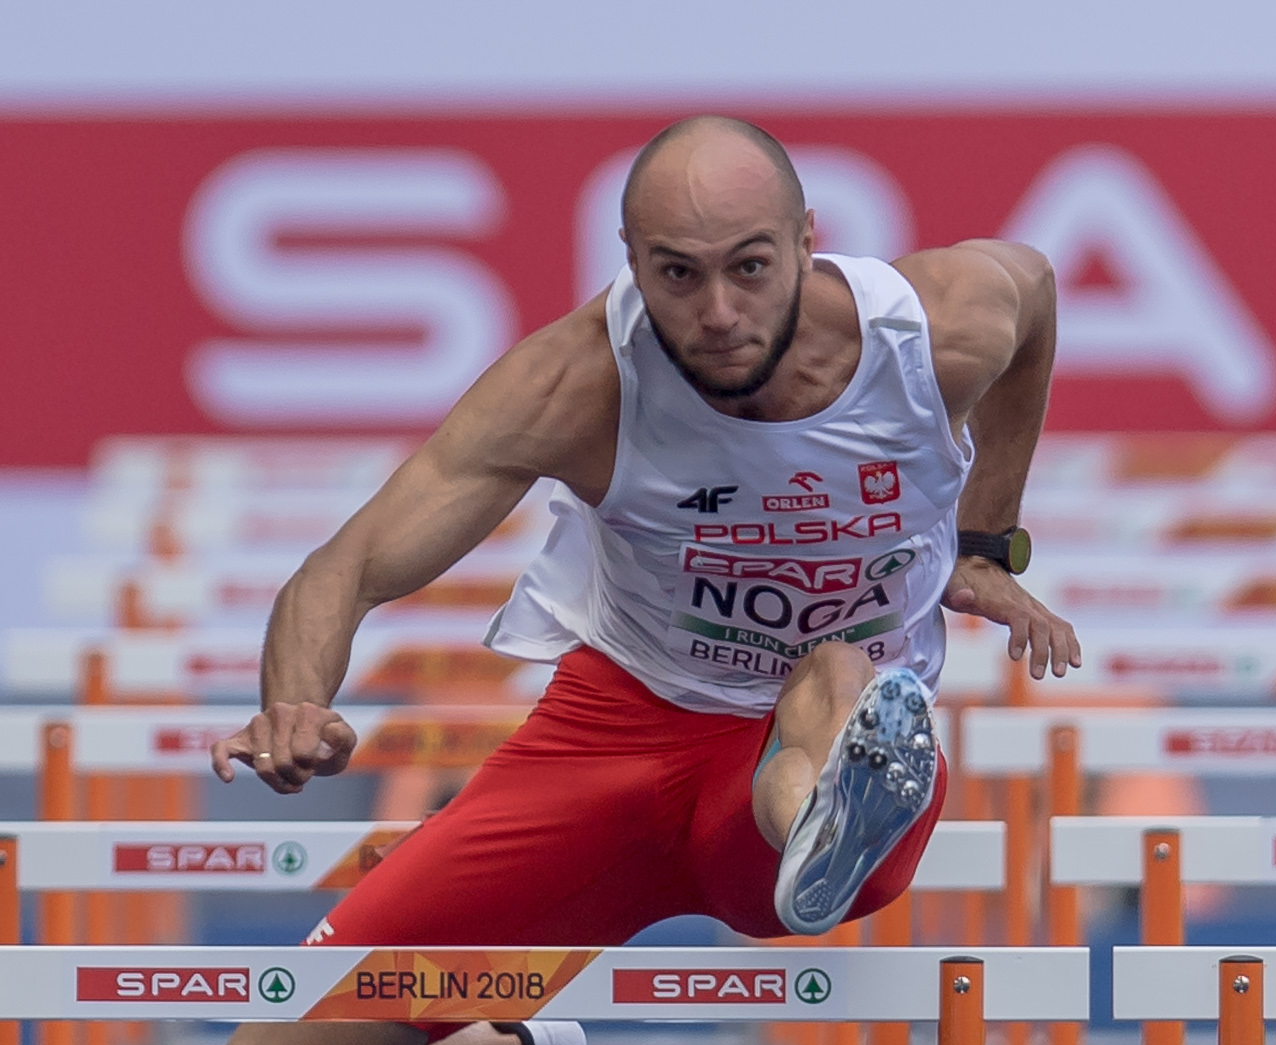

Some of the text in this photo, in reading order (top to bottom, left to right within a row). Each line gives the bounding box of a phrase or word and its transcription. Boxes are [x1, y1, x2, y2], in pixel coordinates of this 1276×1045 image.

[677, 485, 739, 513] 4F
[766, 496, 825, 510] ORLEN
[694, 512, 901, 544] POLSKA
[689, 556, 854, 589] SPAR
[691, 576, 889, 634] NOGA
[724, 628, 730, 639] I
[737, 630, 779, 650] RUN
[690, 639, 793, 677] BERLIN
[147, 846, 263, 869] SPAR
[115, 972, 247, 996] SPAR
[356, 971, 545, 1000] BERLIN 2018
[651, 973, 784, 998] SPAR
